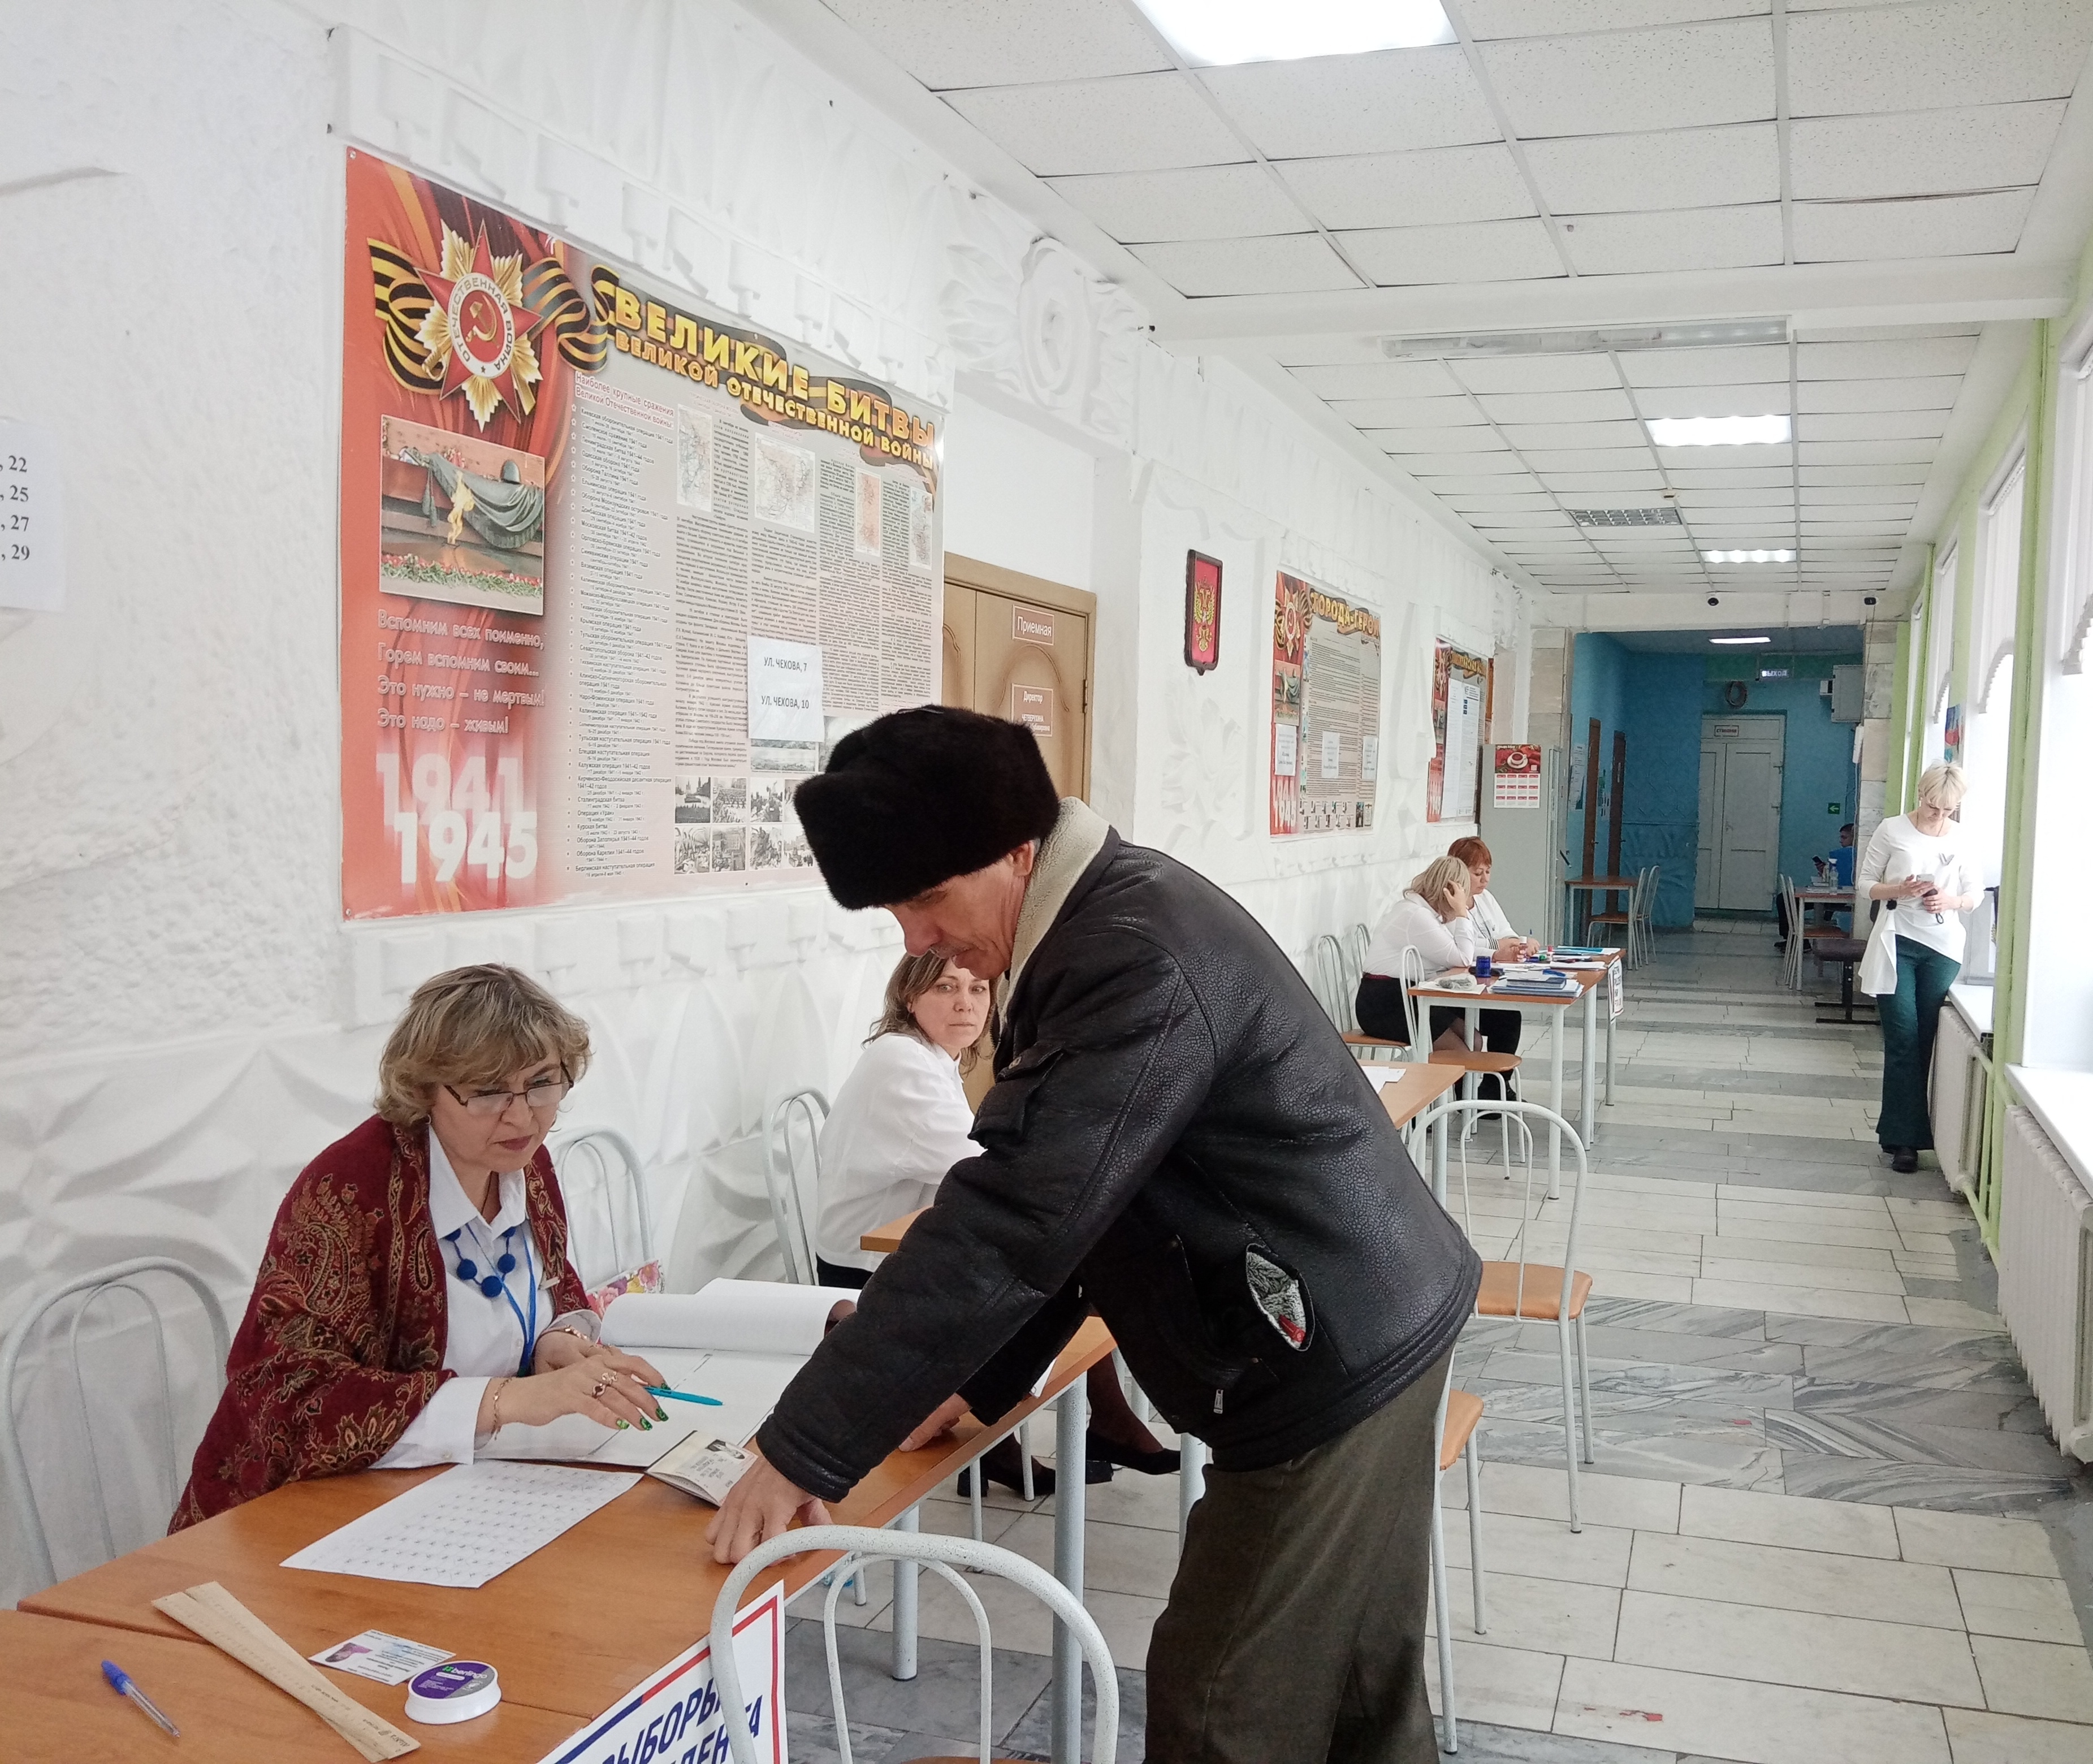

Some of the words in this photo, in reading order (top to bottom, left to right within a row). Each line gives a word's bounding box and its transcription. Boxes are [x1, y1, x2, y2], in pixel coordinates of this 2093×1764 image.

[451, 276, 509, 362] ОТЕЧЕСТВЕННАЯ
[494, 319, 513, 371] ВОЙНА
[615, 286, 810, 400] ВЕЛИКИЕ
[827, 379, 935, 449] БИТВЫ
[576, 374, 610, 394] Наиболее
[613, 388, 641, 405] крупные
[643, 397, 674, 416] сражения
[576, 384, 603, 405] Великой
[606, 397, 651, 421] Отечественной
[652, 416, 674, 429] войны:
[615, 328, 718, 388] ВЕЛИКОЙ
[726, 377, 874, 447] ОТЕЧЕСТВЕННОЙ
[881, 426, 933, 469] ВОЙНЫ
[8, 455, 27, 473] 22
[10, 485, 29, 502] 25
[11, 514, 29, 531] 27
[11, 544, 30, 561] 29
[378, 609, 448, 636] Вспомним
[453, 623, 481, 640] всех
[485, 628, 544, 650] поименно,
[1017, 616, 1052, 637] Приемная
[378, 643, 423, 666] Горем
[427, 653, 490, 672] вспомним
[494, 660, 539, 677] своим...
[764, 656, 775, 667] УЛ.
[776, 658, 802, 672] ЧЕХОВА,
[803, 663, 807, 672] 7
[378, 675, 406, 696] Это
[412, 685, 454, 702] нужно
[474, 688, 489, 702] не
[492, 689, 545, 709] мертвым!
[761, 695, 772, 706] УЛ.
[773, 697, 800, 710] ЧЕХОВА,
[802, 699, 809, 709] 10
[1023, 691, 1043, 704] Директор
[378, 708, 406, 729] Это
[412, 717, 445, 732] надо
[464, 716, 509, 734] живым!
[376, 753, 525, 826] 1941
[394, 811, 538, 884] 1945
[451, 1667, 488, 1679] berlingo
